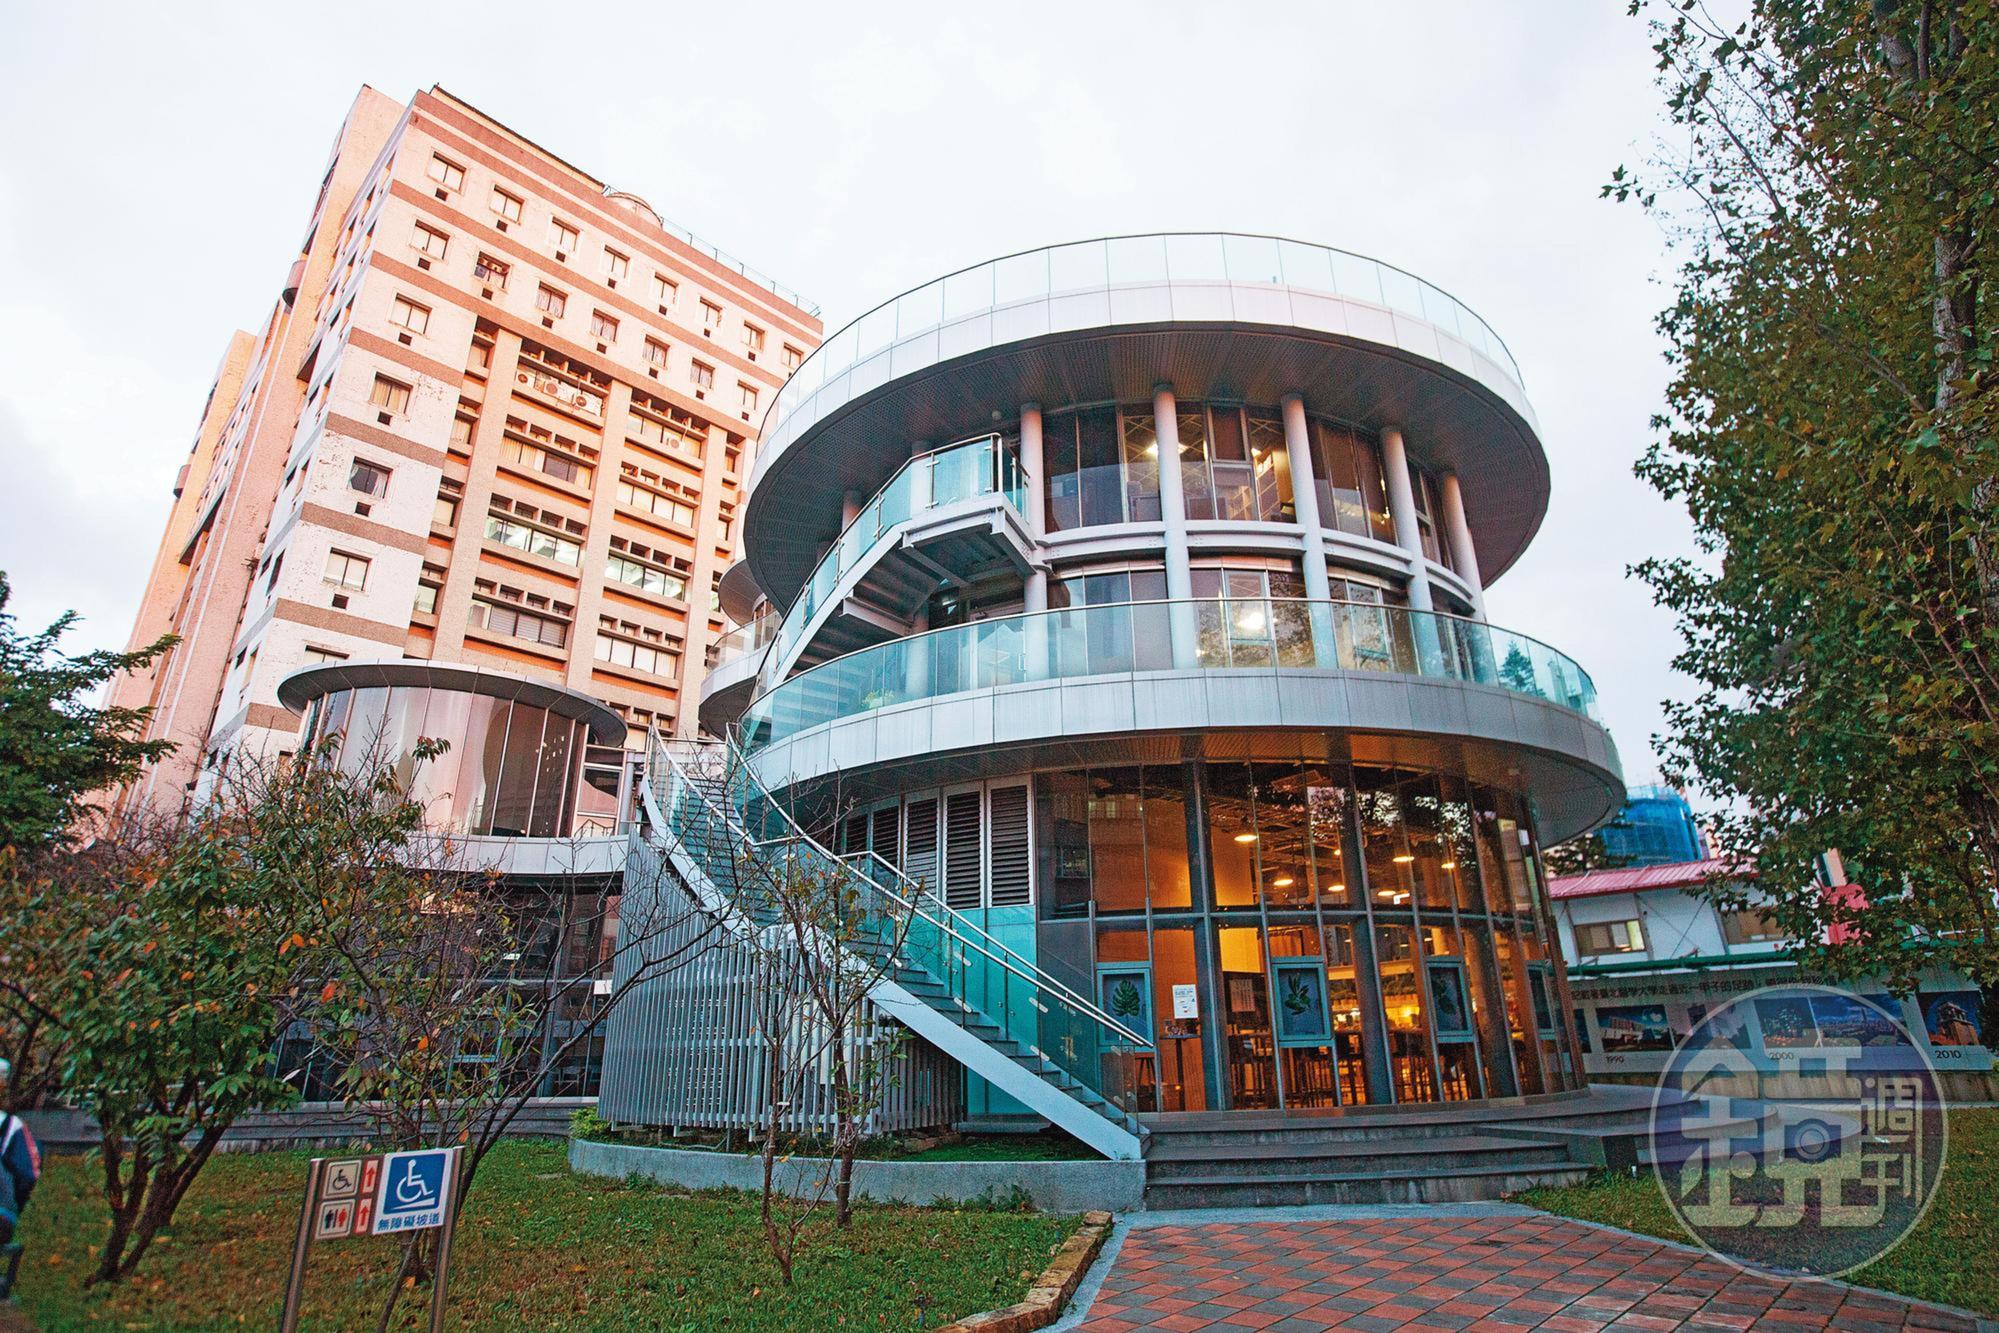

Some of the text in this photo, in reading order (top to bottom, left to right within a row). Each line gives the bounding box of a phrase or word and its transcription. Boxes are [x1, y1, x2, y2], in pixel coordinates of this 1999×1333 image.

[1770, 1052, 1794, 1061] 2000
[1935, 1050, 1961, 1059] 2010
[1606, 1055, 1624, 1064] 1990
[378, 1213, 439, 1231] 無障礙坡道
